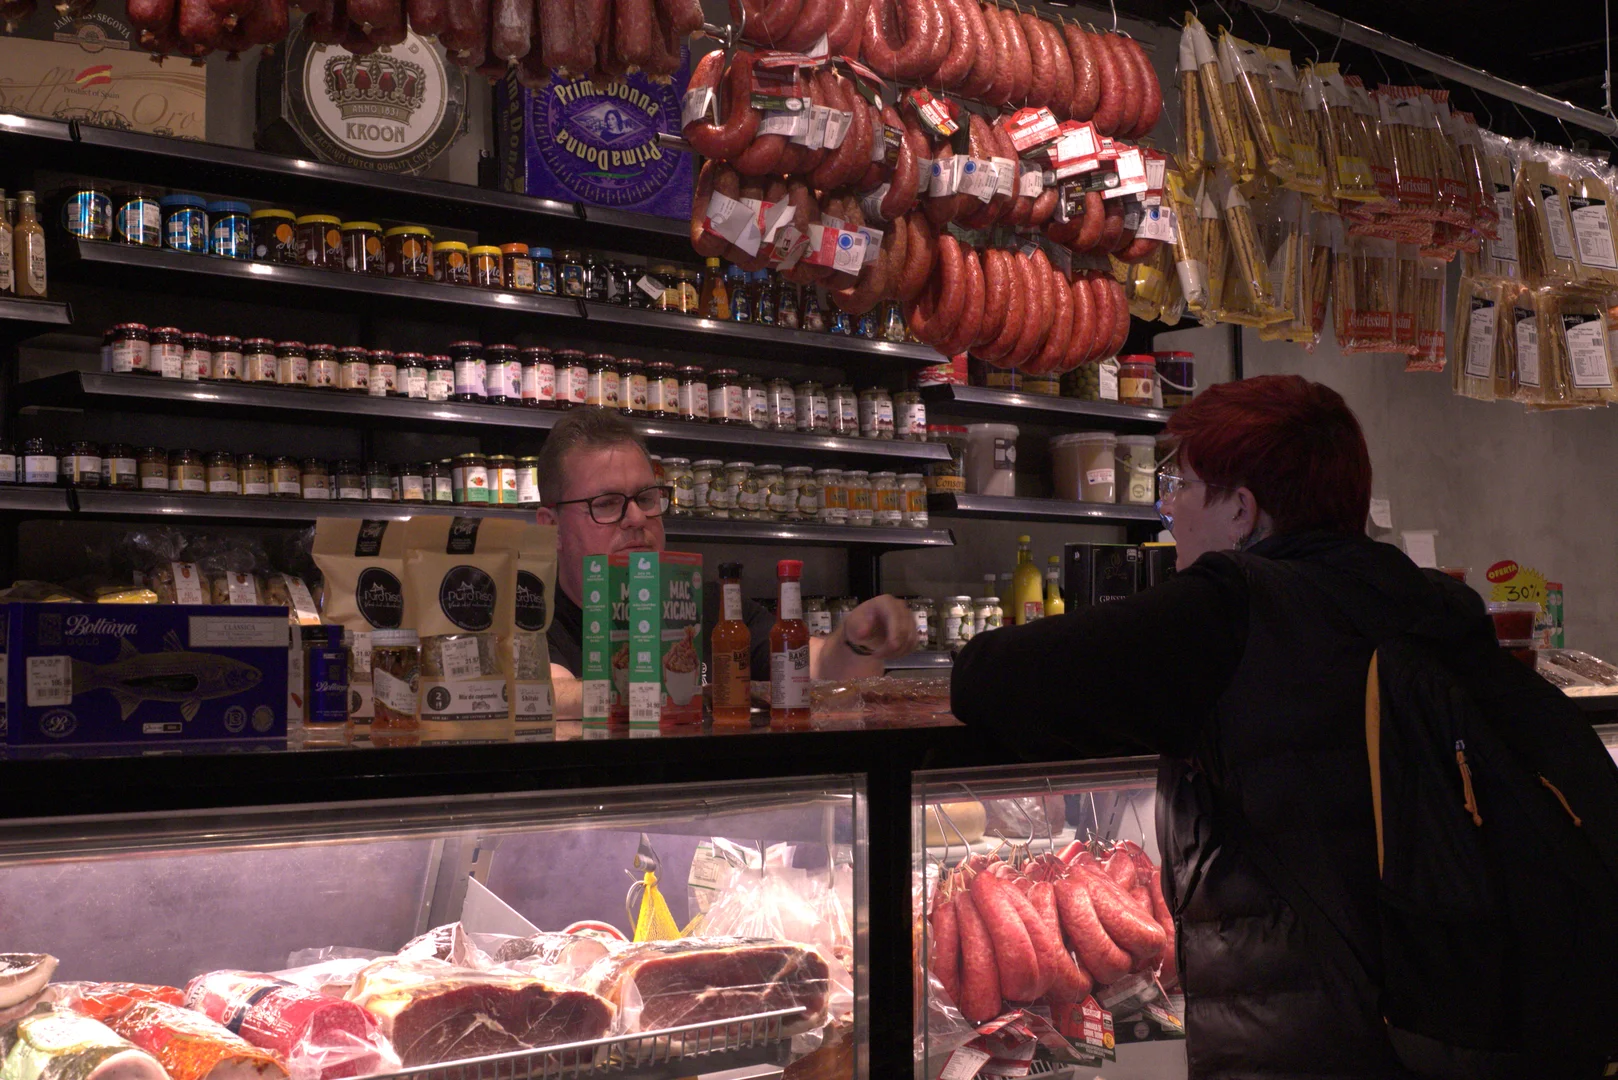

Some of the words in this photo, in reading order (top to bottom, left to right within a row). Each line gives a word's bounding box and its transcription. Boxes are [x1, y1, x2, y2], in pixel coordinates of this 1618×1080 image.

[63, 85, 92, 98] Product
[352, 104, 378, 114] ANNO
[345, 121, 406, 144] KROON
[347, 156, 376, 171] DUTCH
[1399, 179, 1432, 196] Grissini
[1357, 311, 1390, 329] Grissini
[1488, 564, 1518, 580] OFERTA
[668, 580, 692, 600] MAC
[1504, 584, 1540, 602] 30%
[662, 600, 697, 622] XICANO
[435, 691, 442, 701] 2
